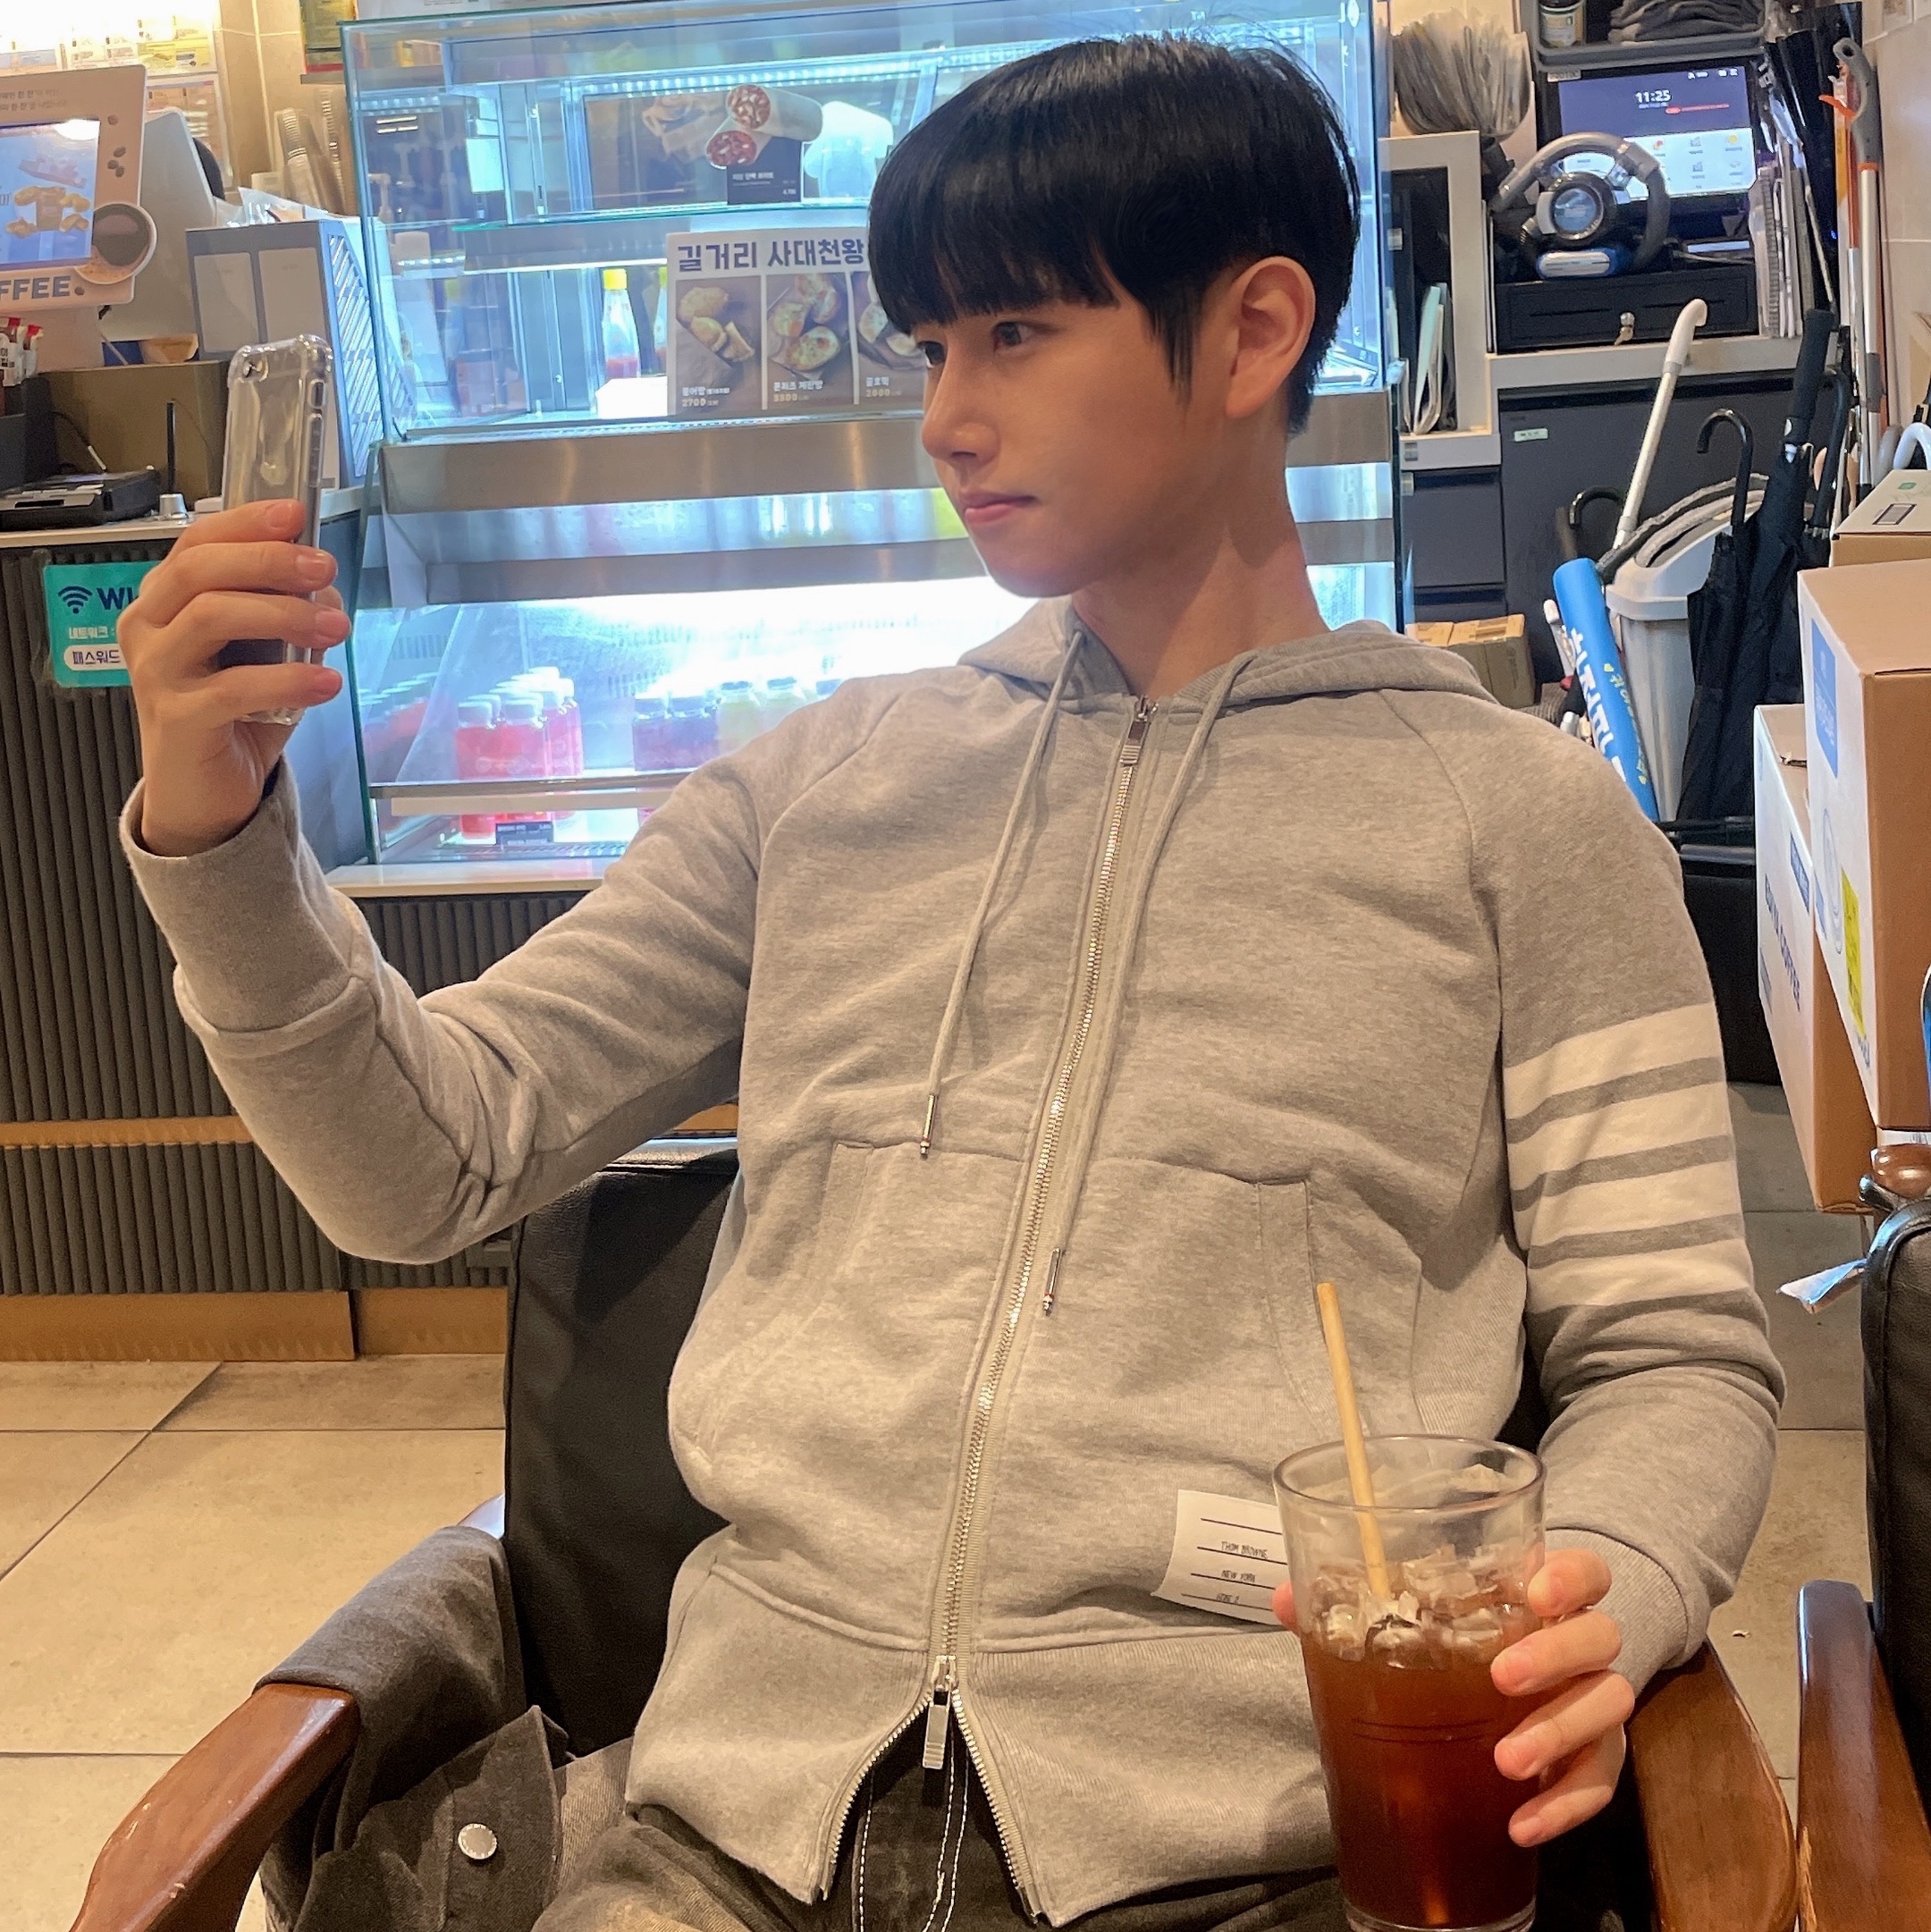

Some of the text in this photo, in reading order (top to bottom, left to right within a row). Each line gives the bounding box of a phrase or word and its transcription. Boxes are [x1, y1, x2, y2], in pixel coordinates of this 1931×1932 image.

[1635, 89, 1672, 103] 11:25
[678, 239, 864, 272] 길거리 사대천왕
[69, 626, 109, 639] 네트워크
[72, 650, 122, 665] 패스워드
